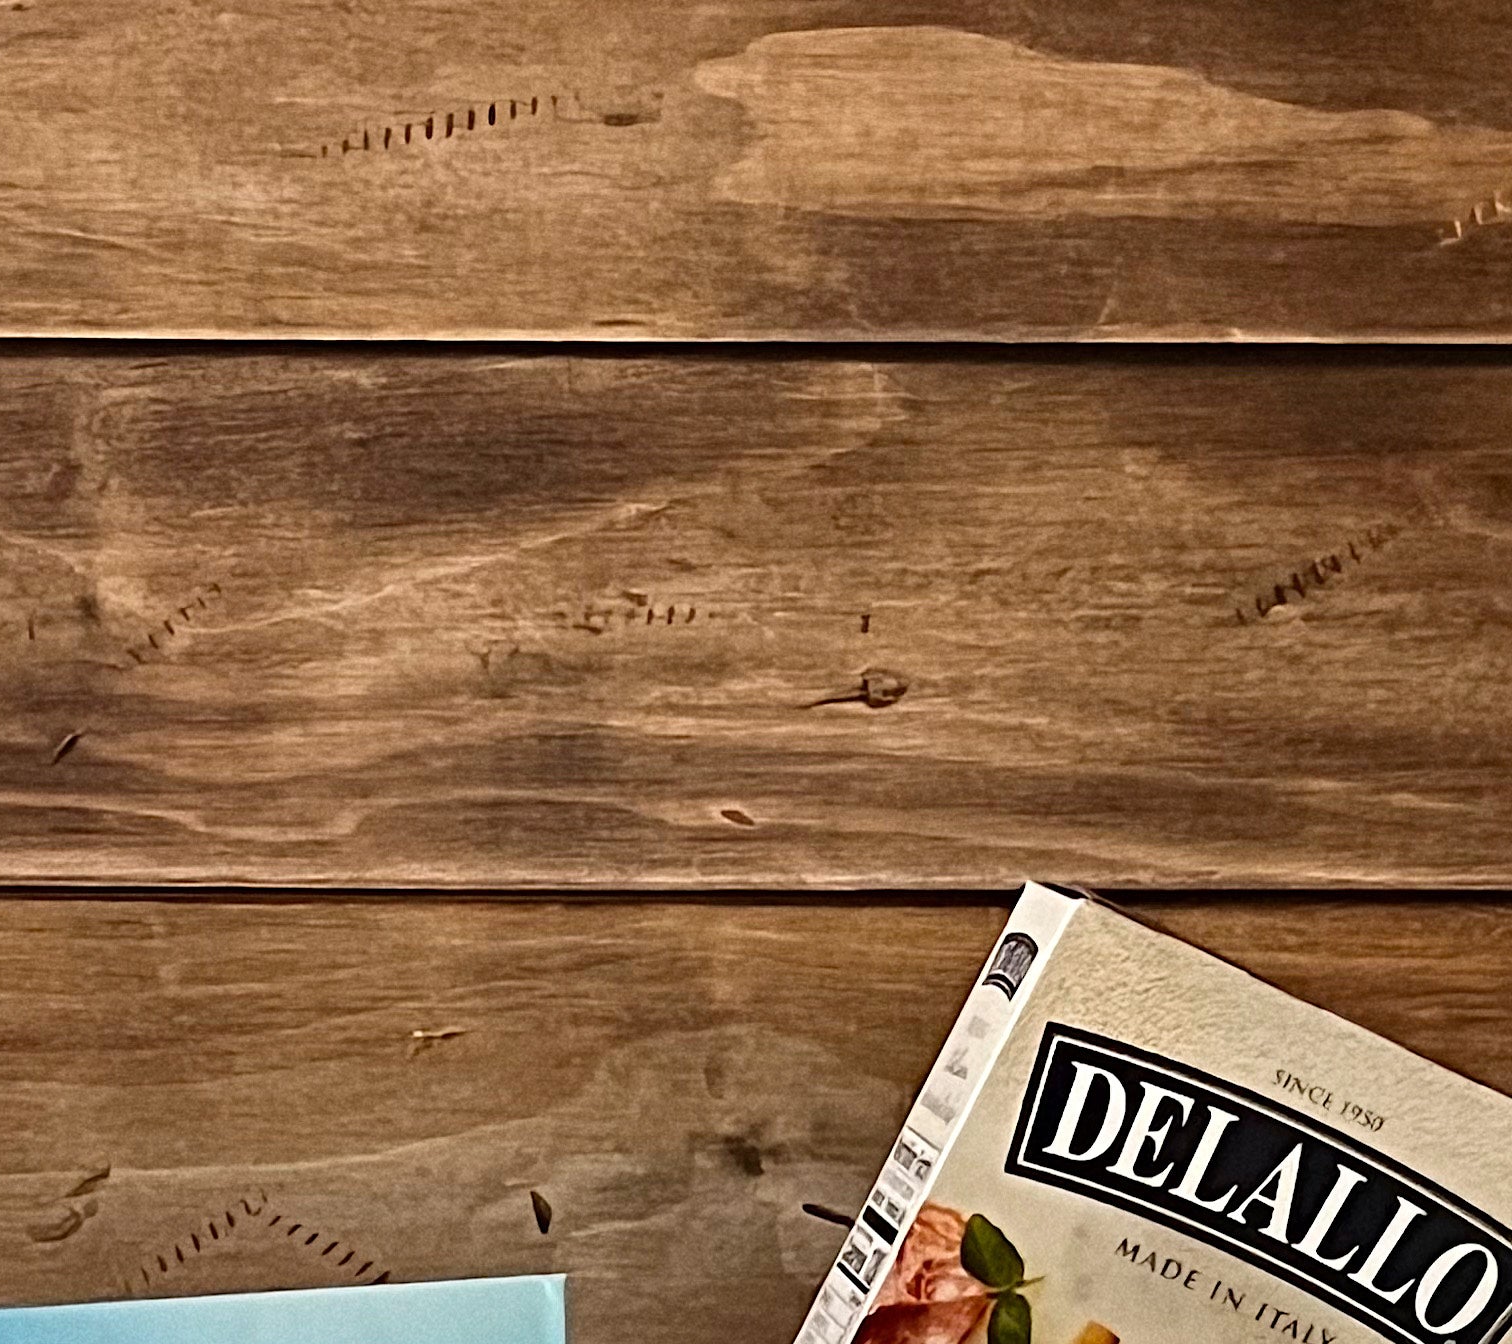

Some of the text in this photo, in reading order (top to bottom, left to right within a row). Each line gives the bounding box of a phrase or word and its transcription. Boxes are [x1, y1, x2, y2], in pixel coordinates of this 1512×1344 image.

[1272, 1069, 1385, 1133] SINCE 1950
[1042, 1061, 1499, 1336] DELALLO
[1115, 1238, 1199, 1290] MADE
[1210, 1281, 1245, 1312] IN
